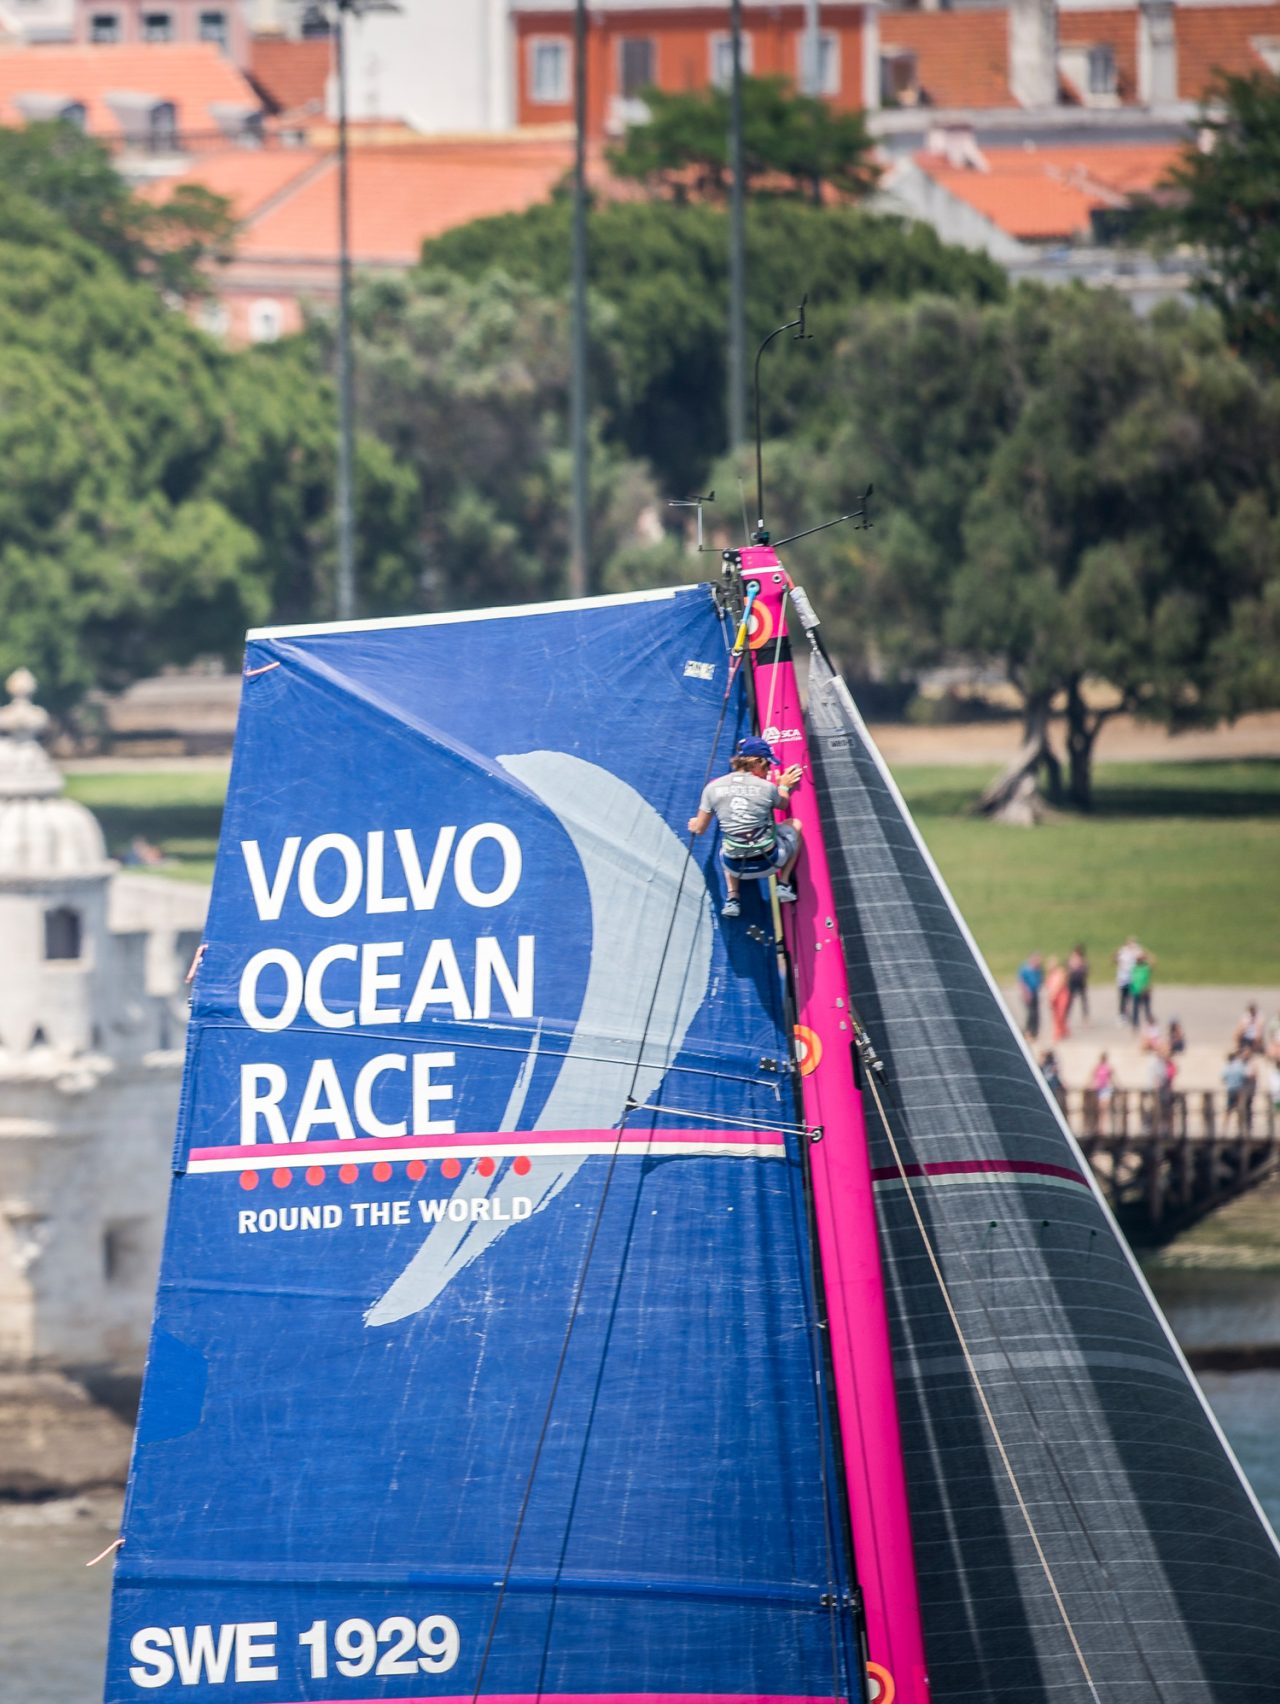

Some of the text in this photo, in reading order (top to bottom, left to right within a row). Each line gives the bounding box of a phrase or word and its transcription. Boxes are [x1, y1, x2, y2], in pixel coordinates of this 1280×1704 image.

[240, 822, 523, 921] VOLVO
[238, 935, 536, 1033] OCEAN
[240, 1051, 457, 1147] RACE
[238, 1196, 533, 1234] ROUND THE WORLD
[129, 1615, 460, 1688] SWE 1929
